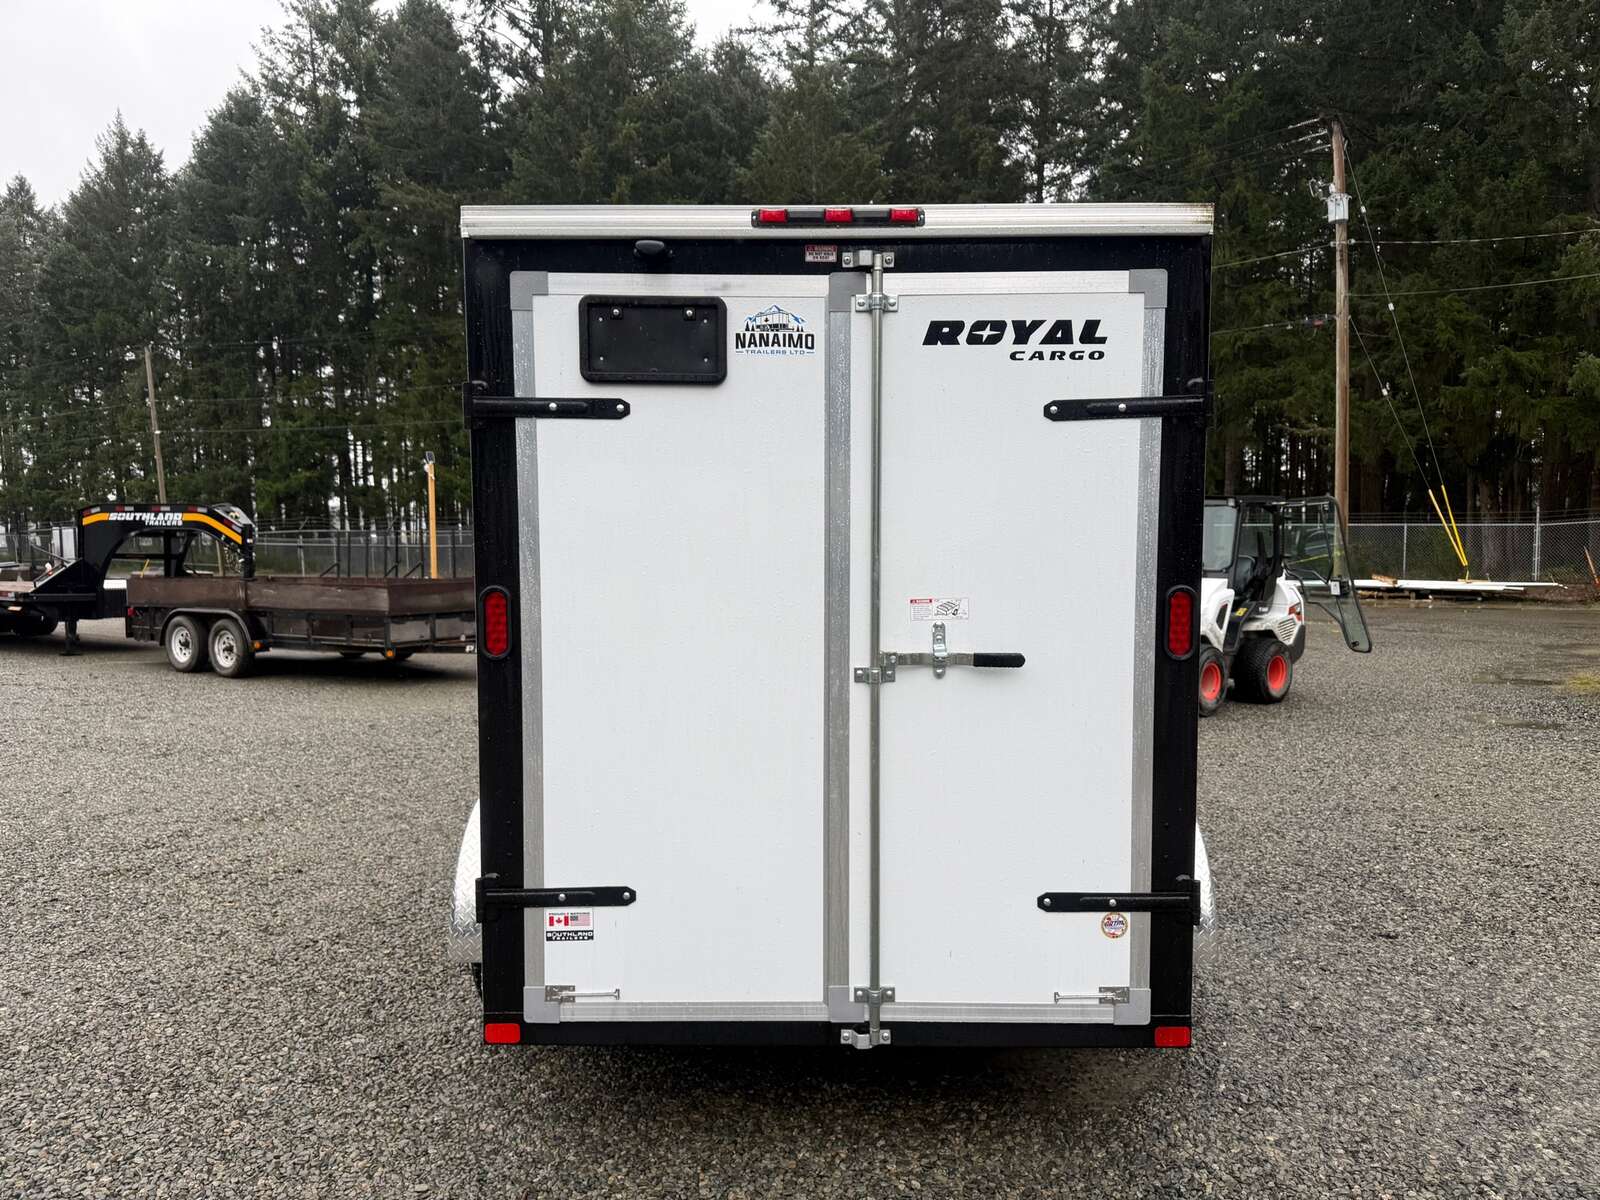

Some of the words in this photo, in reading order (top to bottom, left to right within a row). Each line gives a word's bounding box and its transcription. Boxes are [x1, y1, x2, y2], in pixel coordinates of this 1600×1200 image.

[922, 319, 1108, 345] ROYAL
[735, 333, 815, 350] NANAIMO
[1009, 350, 1105, 361] CARGO
[109, 512, 183, 521] SOUTHLAND
